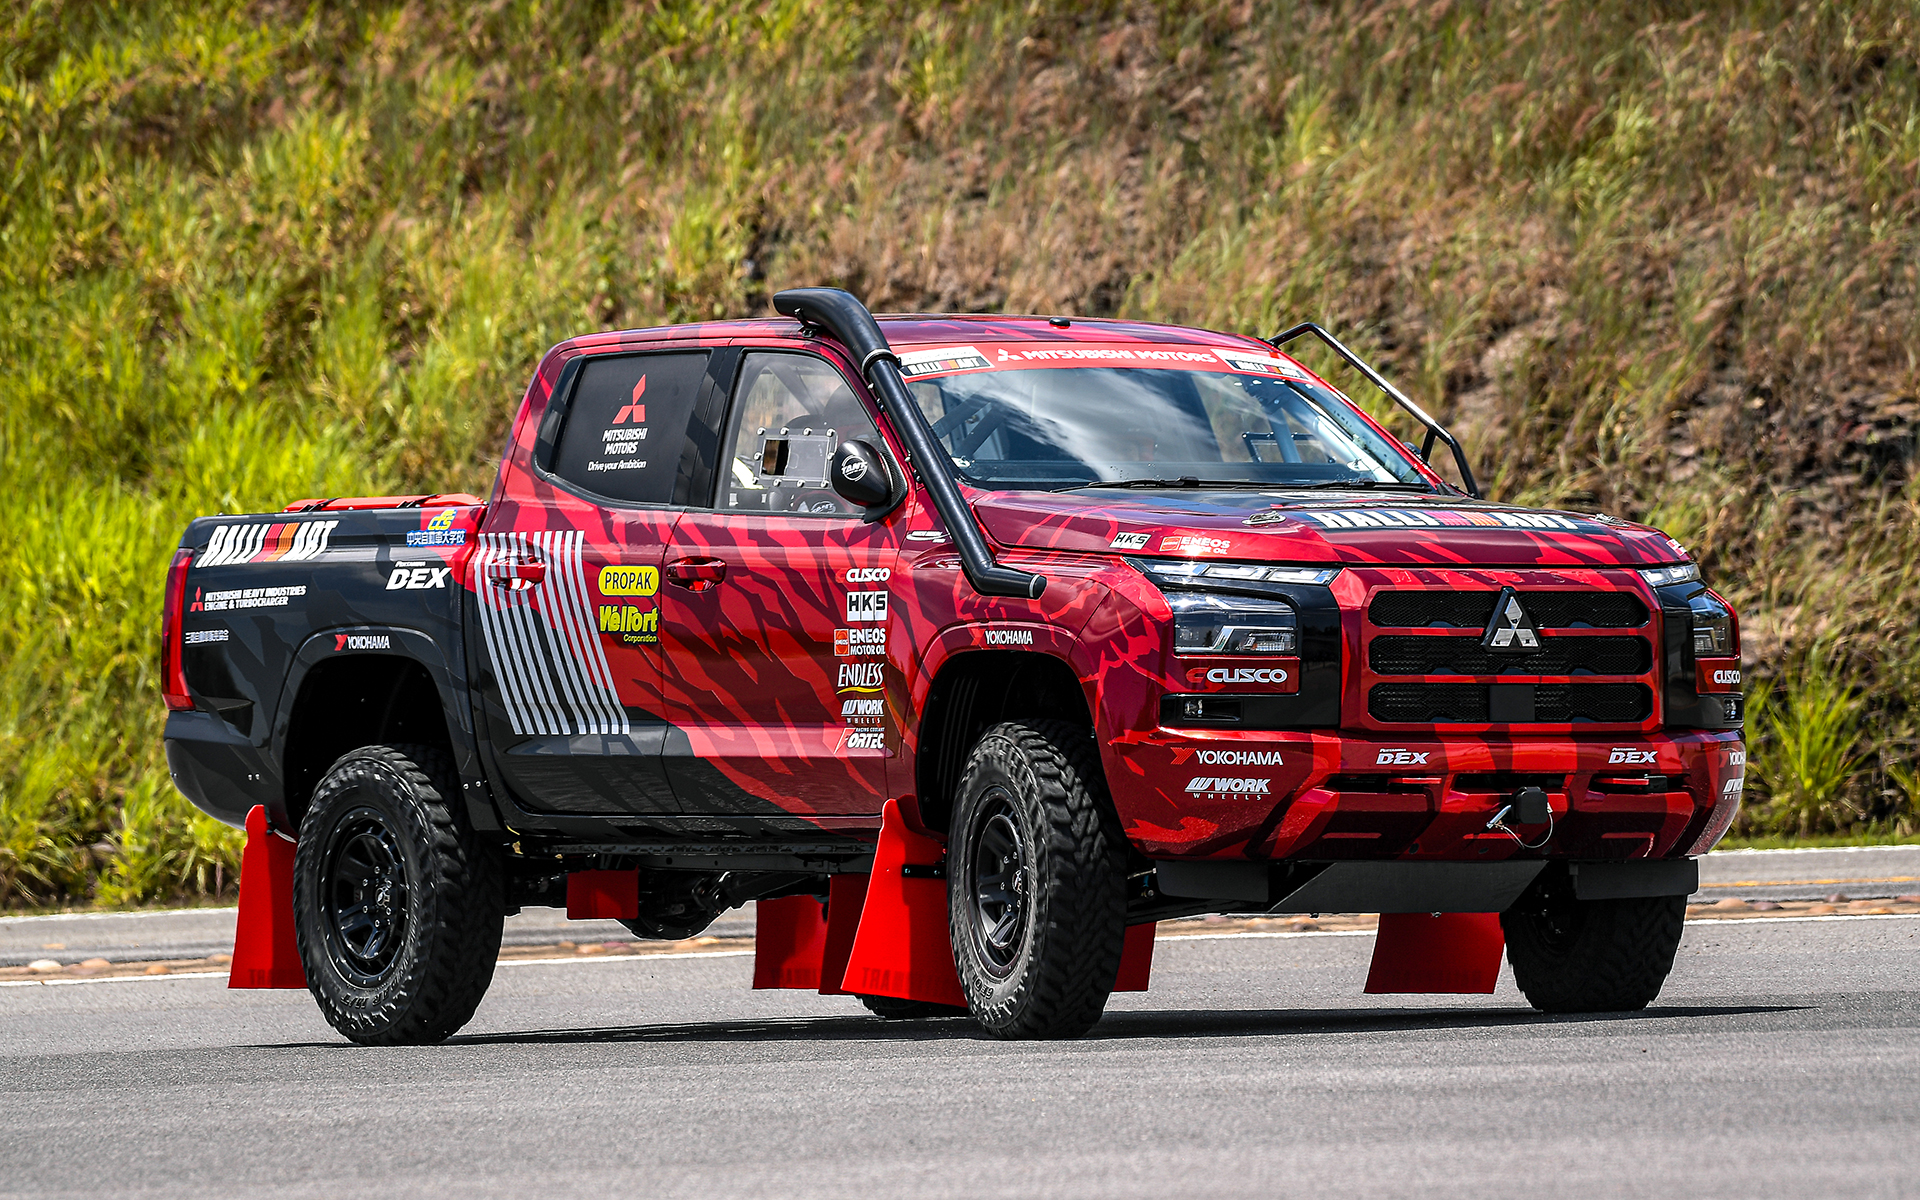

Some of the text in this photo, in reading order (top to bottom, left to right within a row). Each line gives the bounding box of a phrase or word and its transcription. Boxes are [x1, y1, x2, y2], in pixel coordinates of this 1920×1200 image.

[1021, 349, 1137, 360] MITSUBISHI
[1134, 350, 1218, 363] MOTORS
[602, 427, 648, 442] MITSUBISHI
[604, 441, 639, 455] MOTORS
[588, 459, 647, 472] Drive your Ambition
[1114, 534, 1148, 544] HKS
[1181, 536, 1231, 549] ENEOS
[1179, 545, 1211, 553] MOR
[385, 567, 452, 590] DEX
[605, 571, 652, 589] PROPAK
[846, 567, 891, 582] CUSCO
[848, 594, 886, 612] HKS
[347, 635, 390, 649] YOKOHAMA
[849, 628, 886, 643] ENEOS
[984, 630, 1033, 645] YOKOHAMA
[850, 644, 886, 655] MOTOR OIL
[837, 663, 884, 687] ENDLESS
[1206, 668, 1288, 683] CUSCO
[1713, 669, 1741, 684] CUSCO
[857, 699, 884, 715] WORK
[1196, 750, 1283, 766] YOKOHAMA
[1376, 752, 1430, 765] DEX
[1608, 751, 1659, 764] DEX
[1214, 777, 1271, 793] WORK
[1193, 792, 1262, 800] WHEELS
